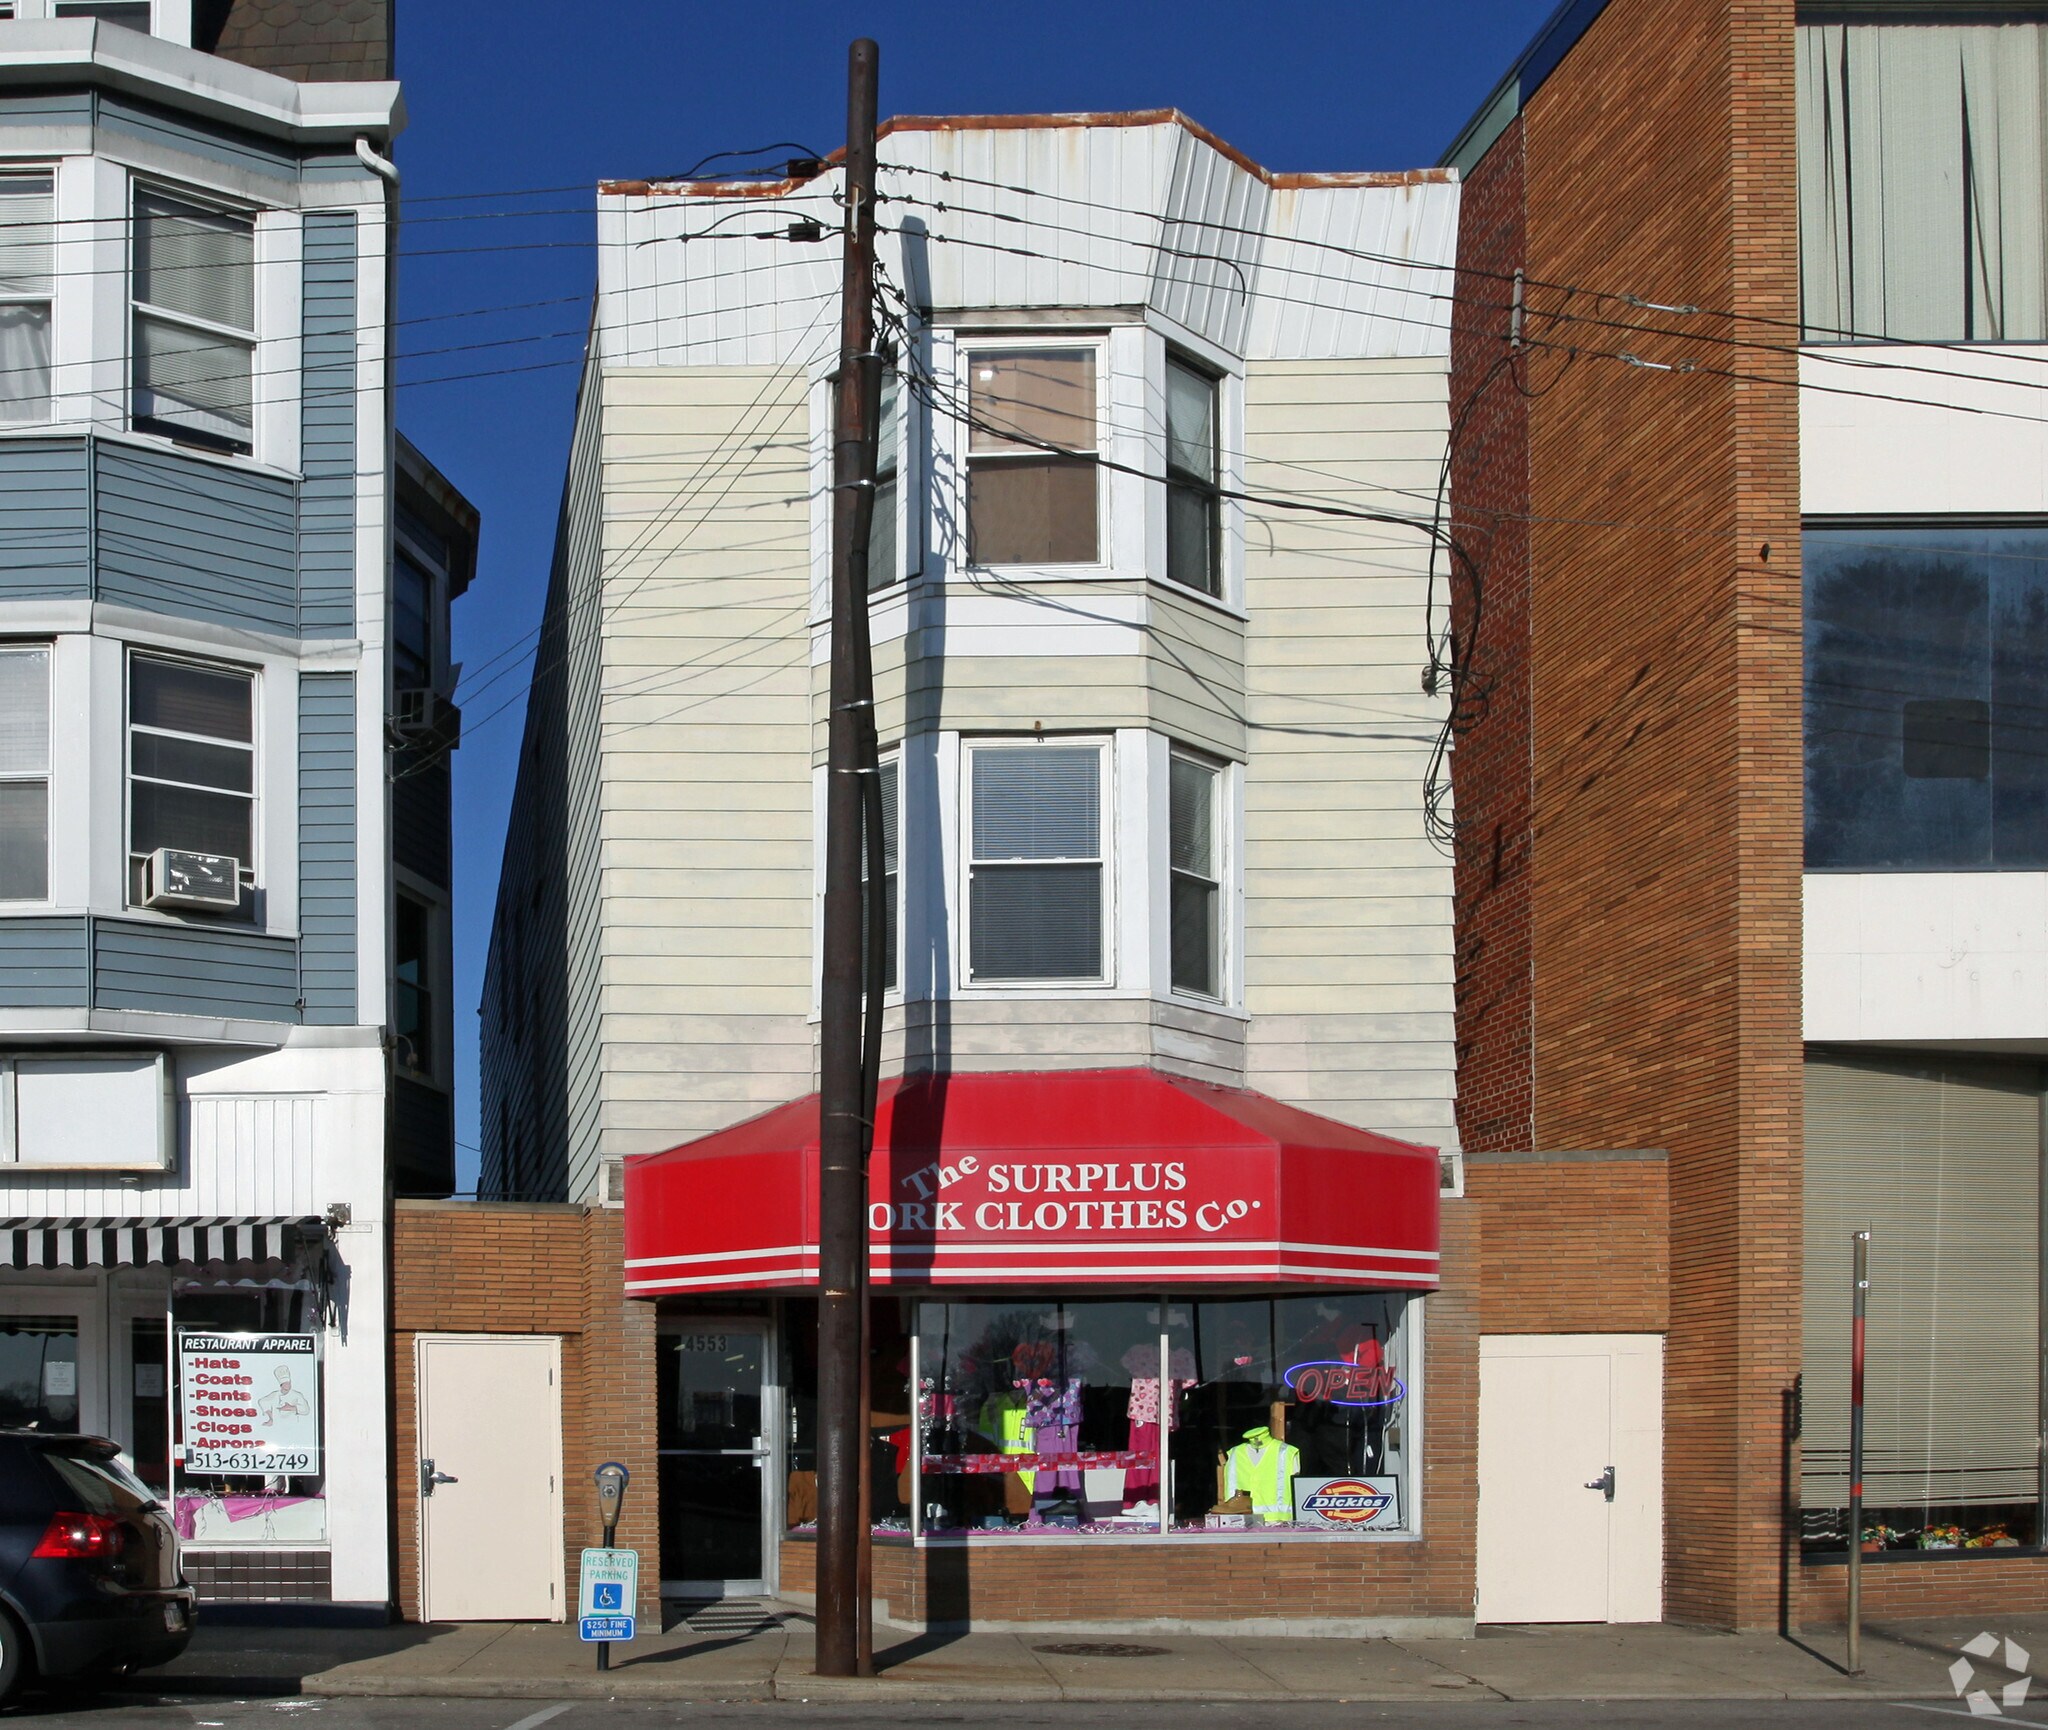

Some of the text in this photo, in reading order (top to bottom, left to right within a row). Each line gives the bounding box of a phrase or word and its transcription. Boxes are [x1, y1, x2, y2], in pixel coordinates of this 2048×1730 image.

[901, 1155, 1187, 1201] The SURPLUS
[868, 1199, 1261, 1232] ORK CLOTHES Co.
[184, 1338, 312, 1350] RESTAURANT APPAREL
[685, 1335, 727, 1352] 4553
[188, 1357, 241, 1369] -Hats
[189, 1373, 253, 1386] -Coats
[1296, 1367, 1395, 1402] OPEN
[189, 1389, 252, 1402] -Pants
[190, 1405, 258, 1418] -Shoes
[190, 1422, 253, 1435] -Clogs
[194, 1452, 309, 1470] 513-631-2749
[1312, 1496, 1384, 1508] Dickies
[586, 1556, 633, 1567] RESERVED
[590, 1570, 628, 1580] PARKING
[587, 1621, 627, 1629] $250 FINE
[591, 1629, 623, 1637] MINIMUM
